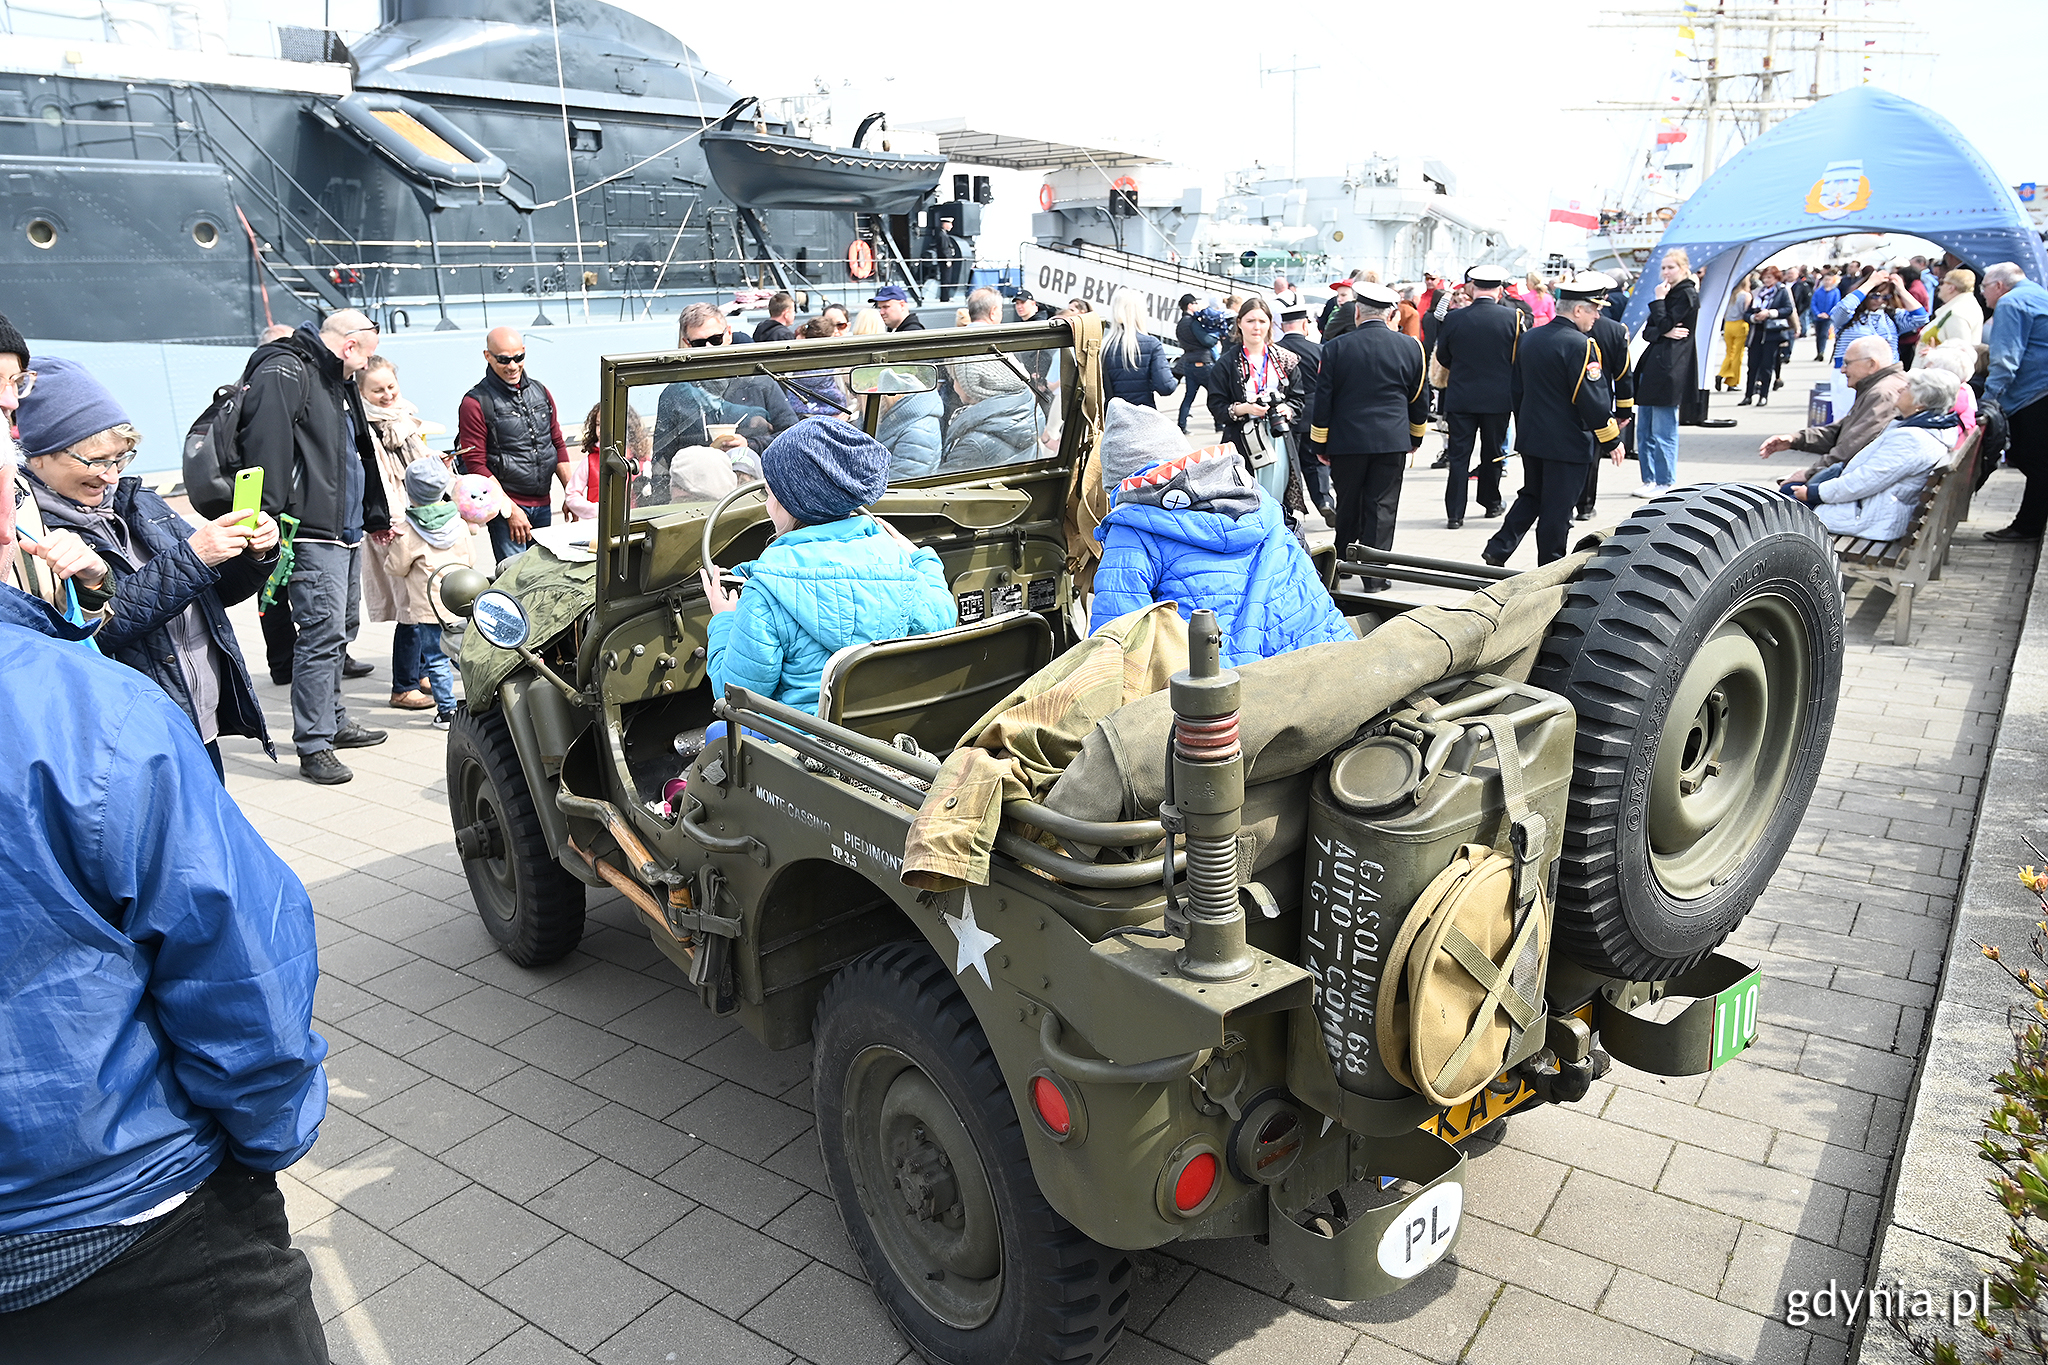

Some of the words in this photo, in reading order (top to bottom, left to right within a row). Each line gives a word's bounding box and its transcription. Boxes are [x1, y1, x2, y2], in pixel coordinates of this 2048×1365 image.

[1039, 265, 1077, 295] ORP
[1729, 558, 1768, 597] NYLON
[756, 785, 786, 813] MONTE
[787, 803, 832, 836] CASSINO
[831, 844, 844, 860] TP
[1350, 860, 1385, 1025] GASOLINE
[1717, 984, 1758, 1058] 110
[1345, 1032, 1370, 1076] 68
[1405, 1205, 1451, 1264] PL
